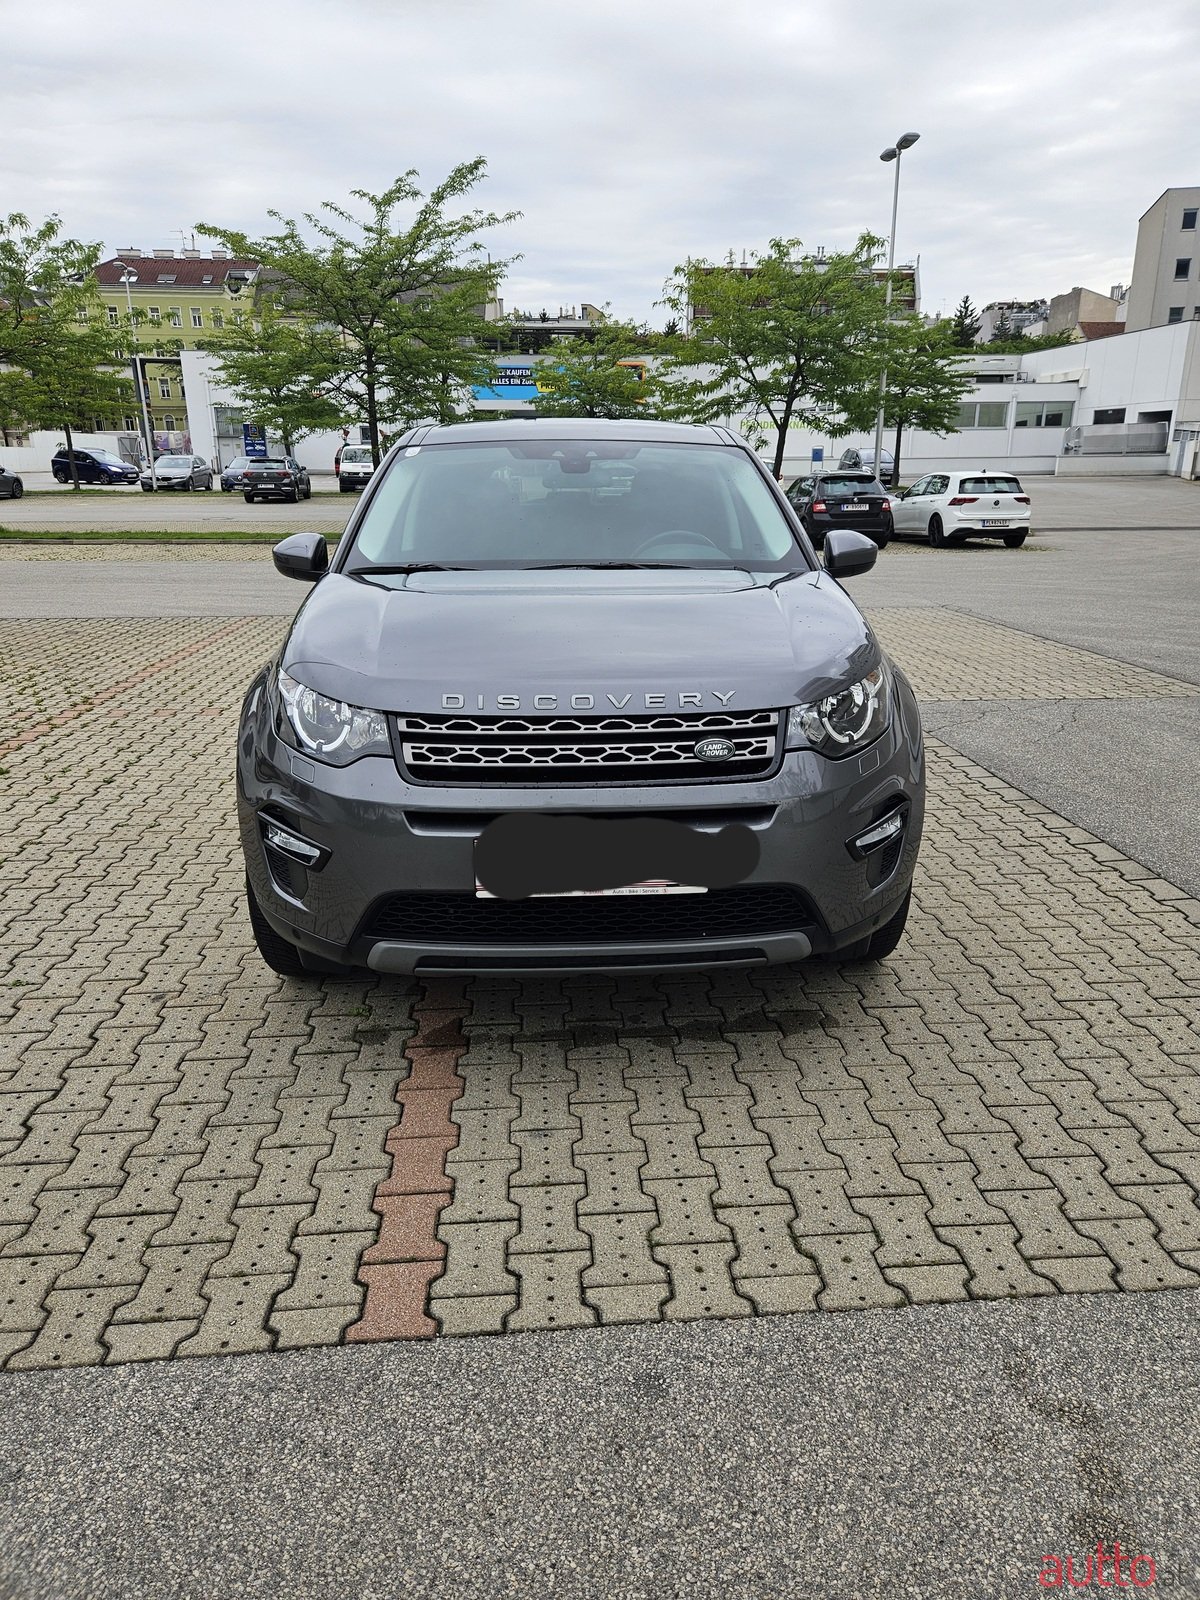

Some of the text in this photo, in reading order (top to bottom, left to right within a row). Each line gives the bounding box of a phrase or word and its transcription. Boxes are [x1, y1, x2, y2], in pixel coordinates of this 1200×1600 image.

[441, 690, 737, 710] DISCOVERY
[703, 743, 723, 751] LAND
[705, 749, 729, 757] ROVER
